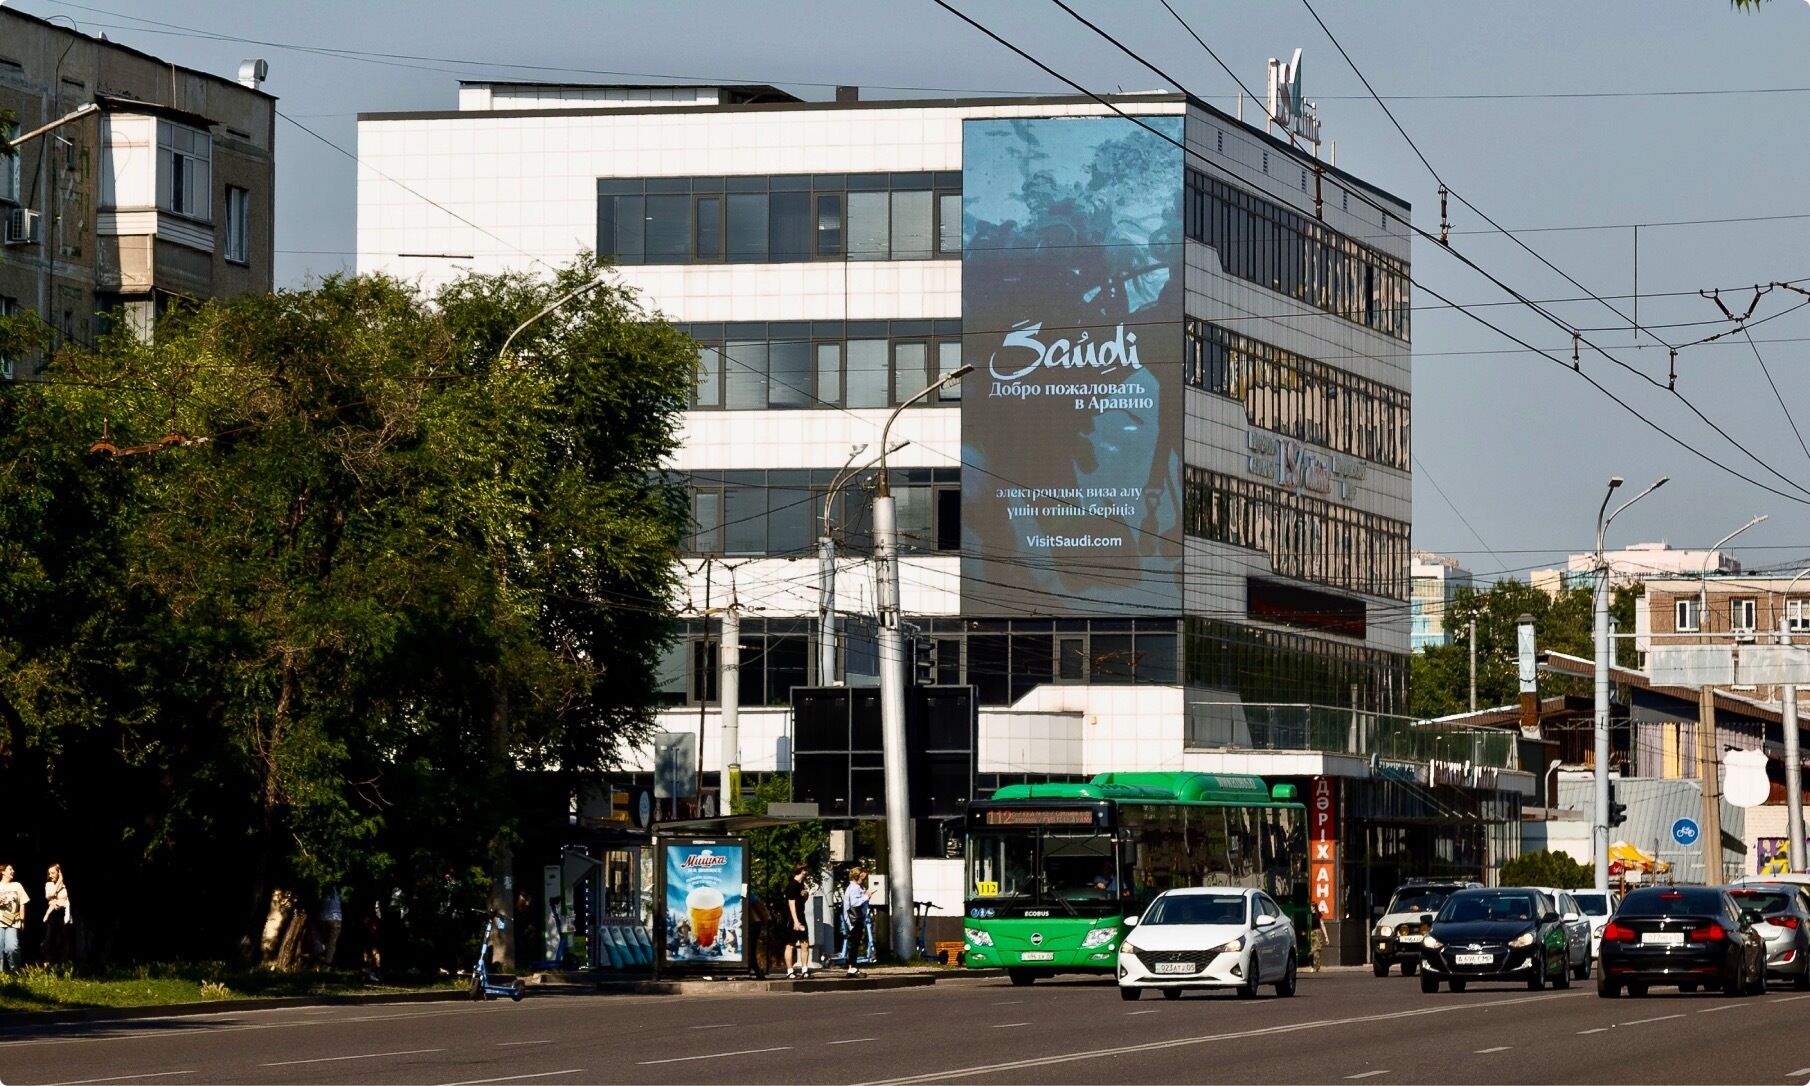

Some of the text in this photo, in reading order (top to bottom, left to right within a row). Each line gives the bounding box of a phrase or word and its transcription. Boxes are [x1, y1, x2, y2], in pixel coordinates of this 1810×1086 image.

[988, 319, 1143, 380] Saudi
[988, 381, 1145, 399] Добро пожаловать
[1075, 396, 1154, 412] в Аравию
[996, 487, 1143, 501] электрондық виза алу
[1007, 503, 1135, 519] үшін өтініш беріңіз
[1026, 535, 1122, 548] VisitSaudi.com
[988, 809, 1011, 825] 112
[1316, 779, 1330, 914] ДӘРІХАНА
[681, 854, 726, 868] Мишка
[980, 883, 996, 894] 112
